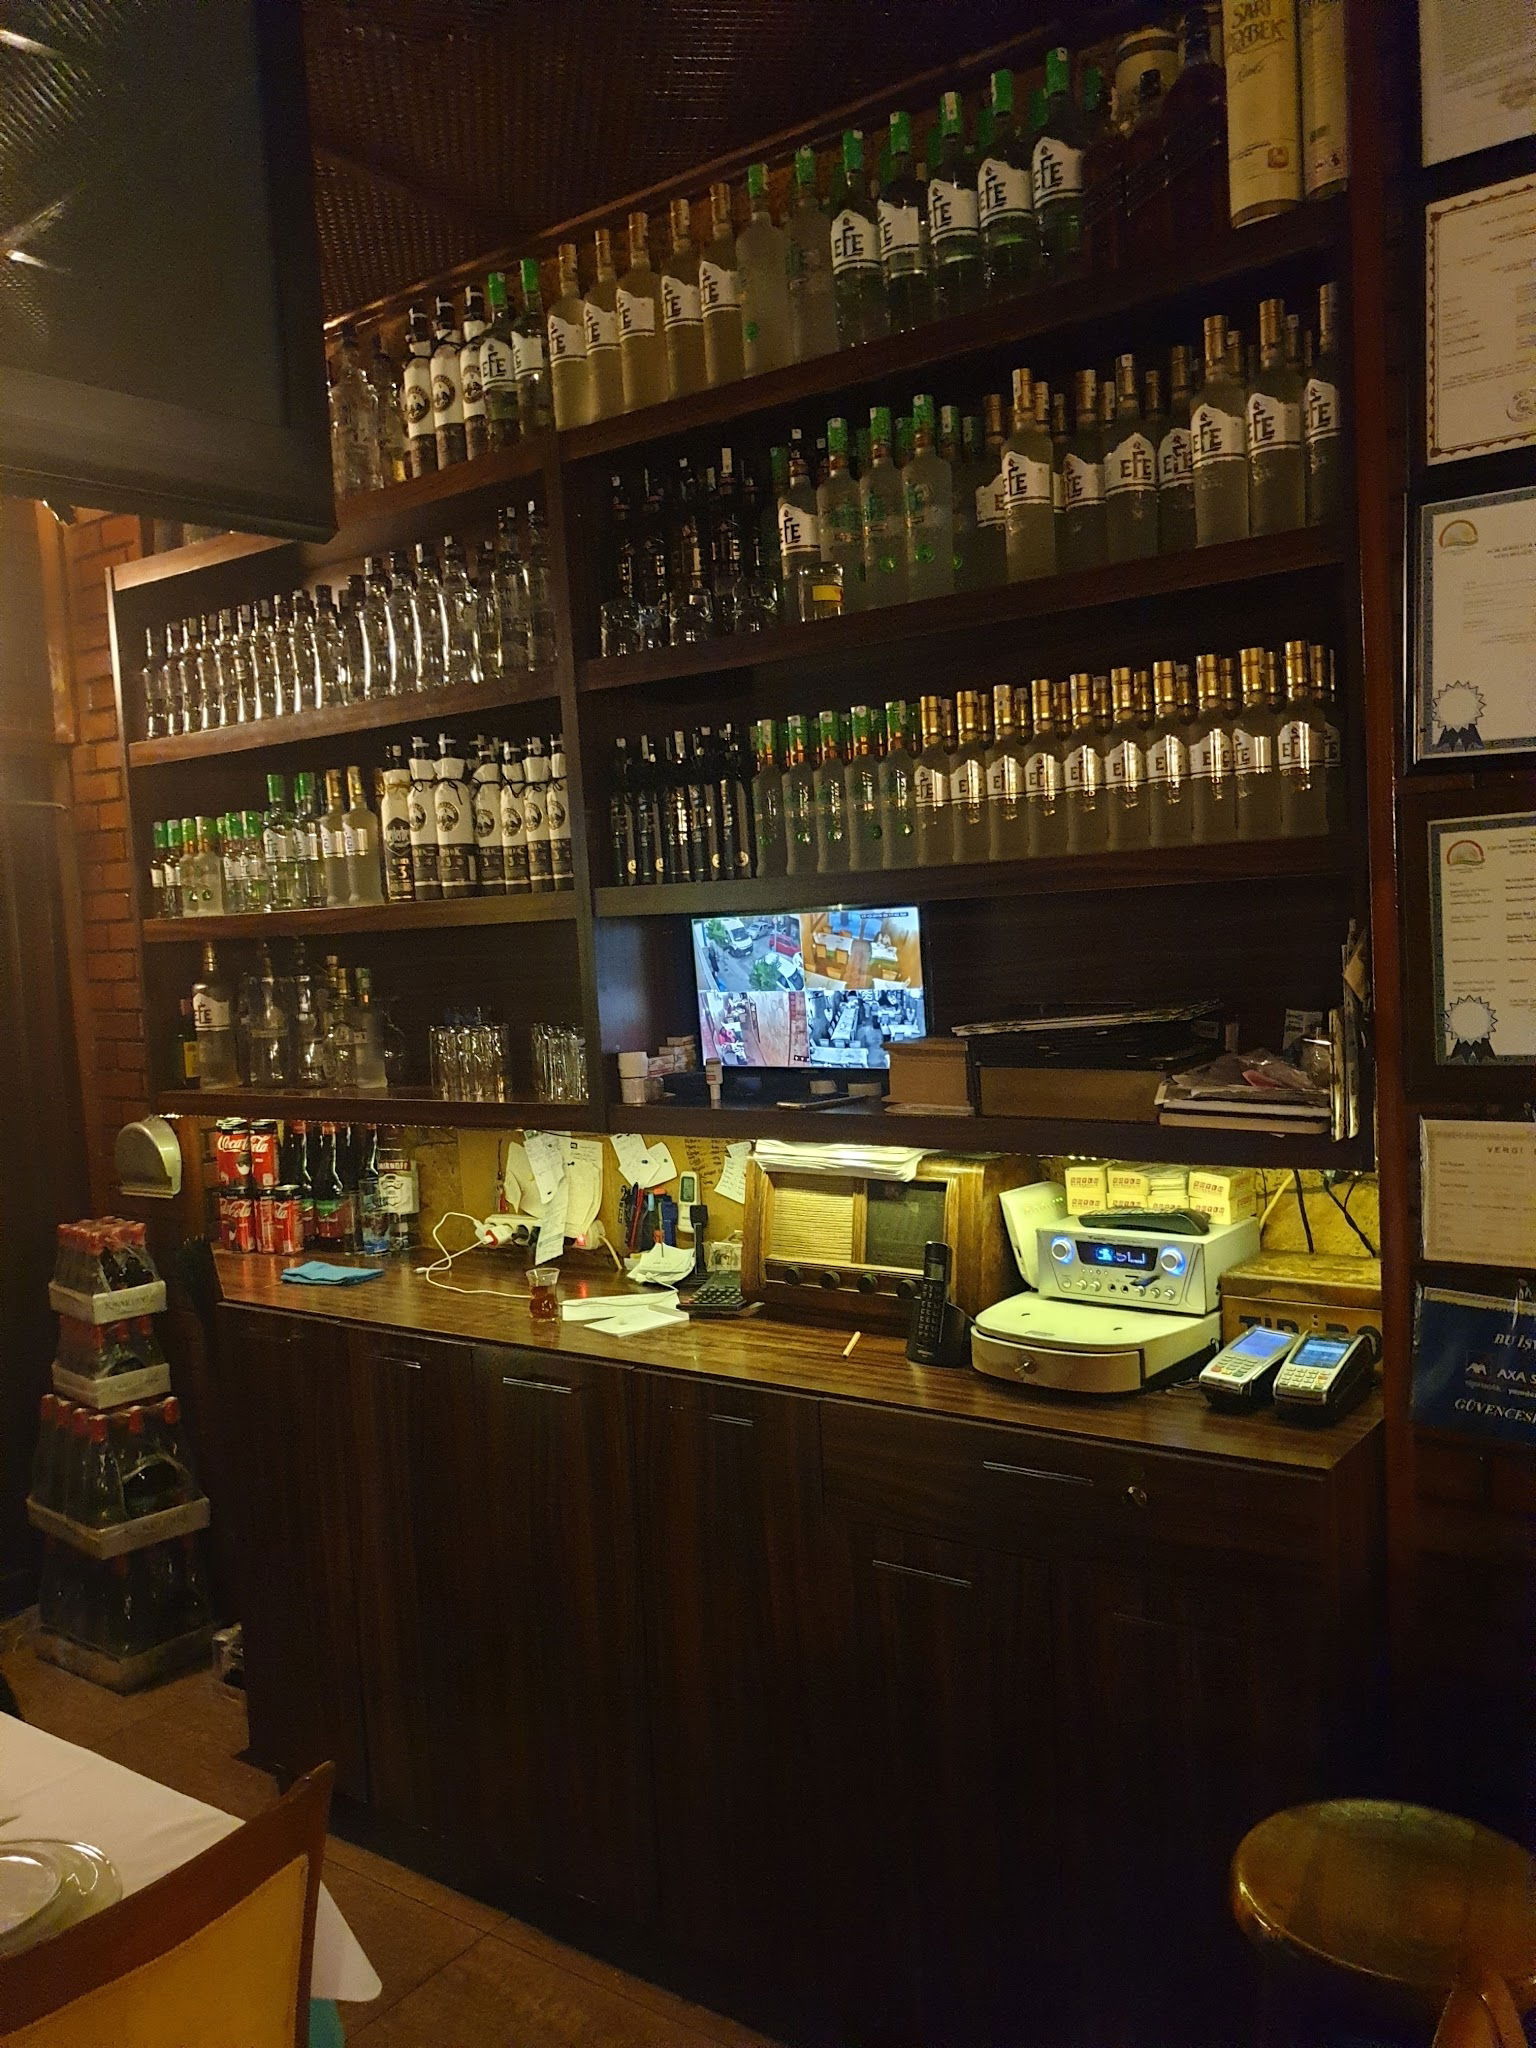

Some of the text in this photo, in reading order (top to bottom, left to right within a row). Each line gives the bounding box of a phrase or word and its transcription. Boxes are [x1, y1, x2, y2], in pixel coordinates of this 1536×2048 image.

[834, 226, 863, 257] EFE
[481, 352, 505, 378] EFE
[1192, 421, 1221, 453] EFE
[1120, 451, 1152, 480] EFE
[1496, 1368, 1526, 1383] AXA
